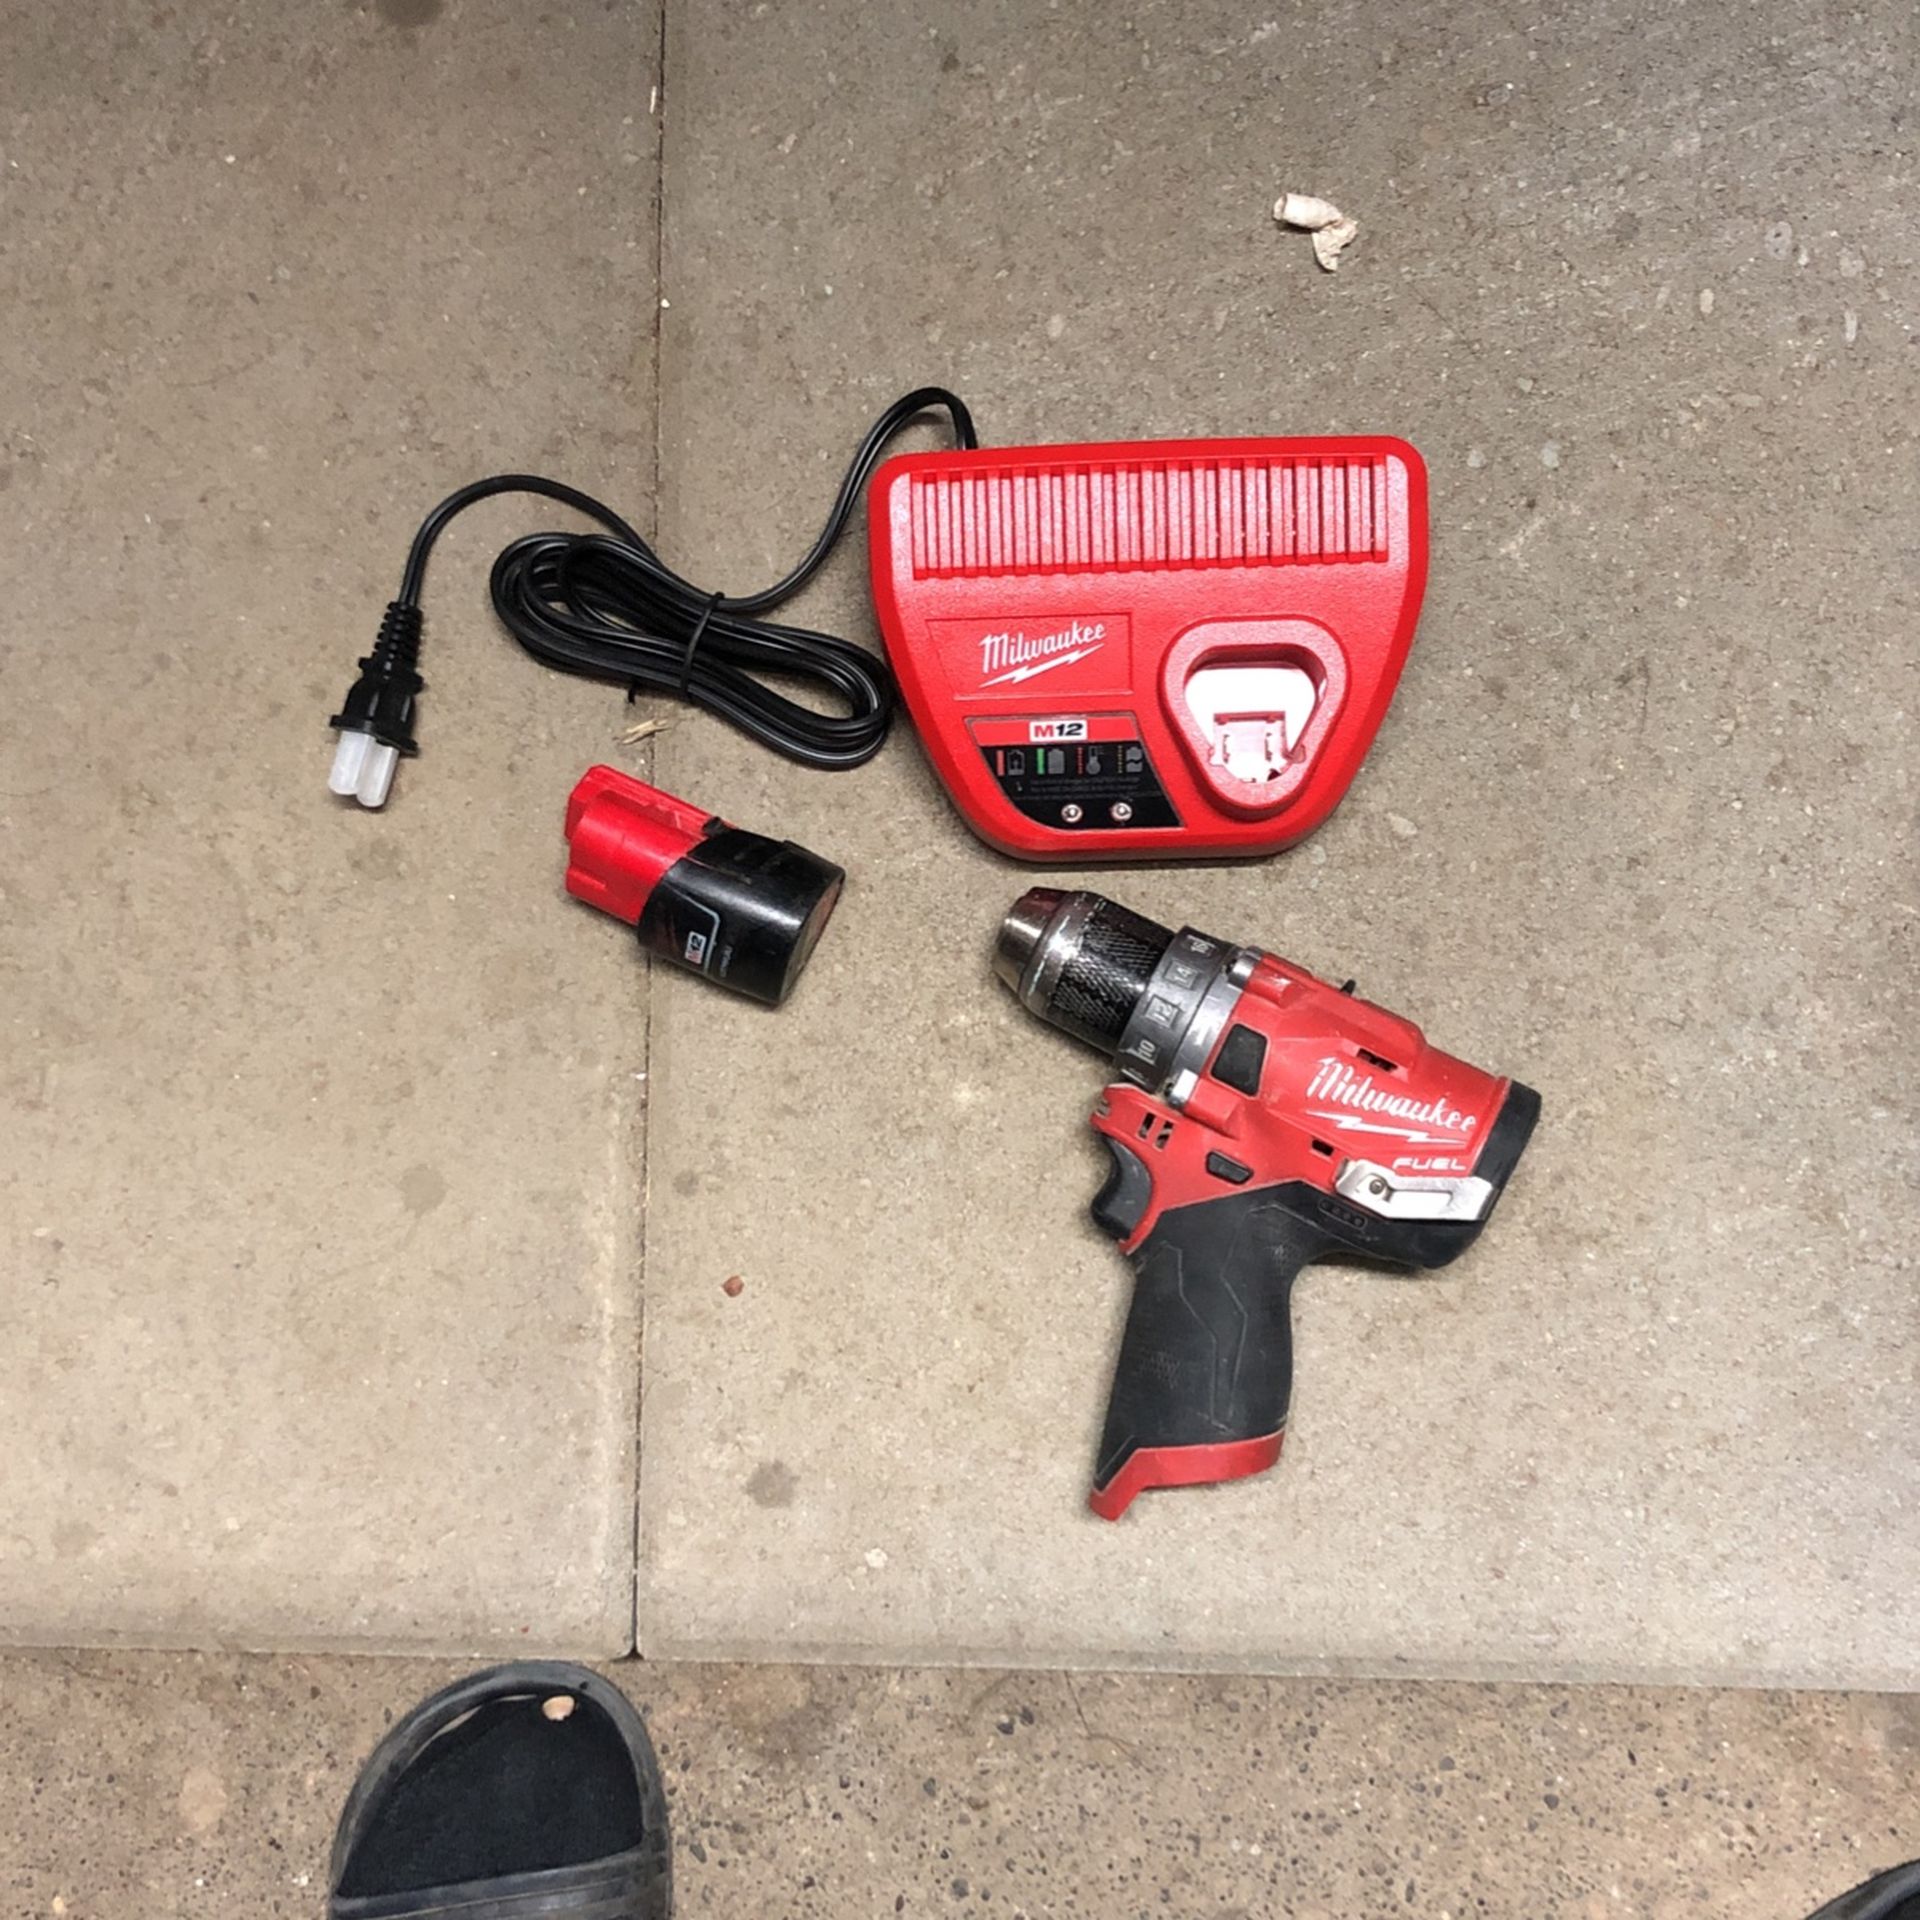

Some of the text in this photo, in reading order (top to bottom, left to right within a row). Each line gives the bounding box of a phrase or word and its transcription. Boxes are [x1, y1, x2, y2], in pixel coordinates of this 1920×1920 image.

[979, 621, 1106, 673] Milwaukee
[1033, 723, 1083, 737] M12
[1174, 966, 1192, 983] 14
[1153, 1003, 1173, 1022] 12
[1306, 1057, 1476, 1132] Milwaukee
[1392, 1157, 1467, 1171] FUEL
